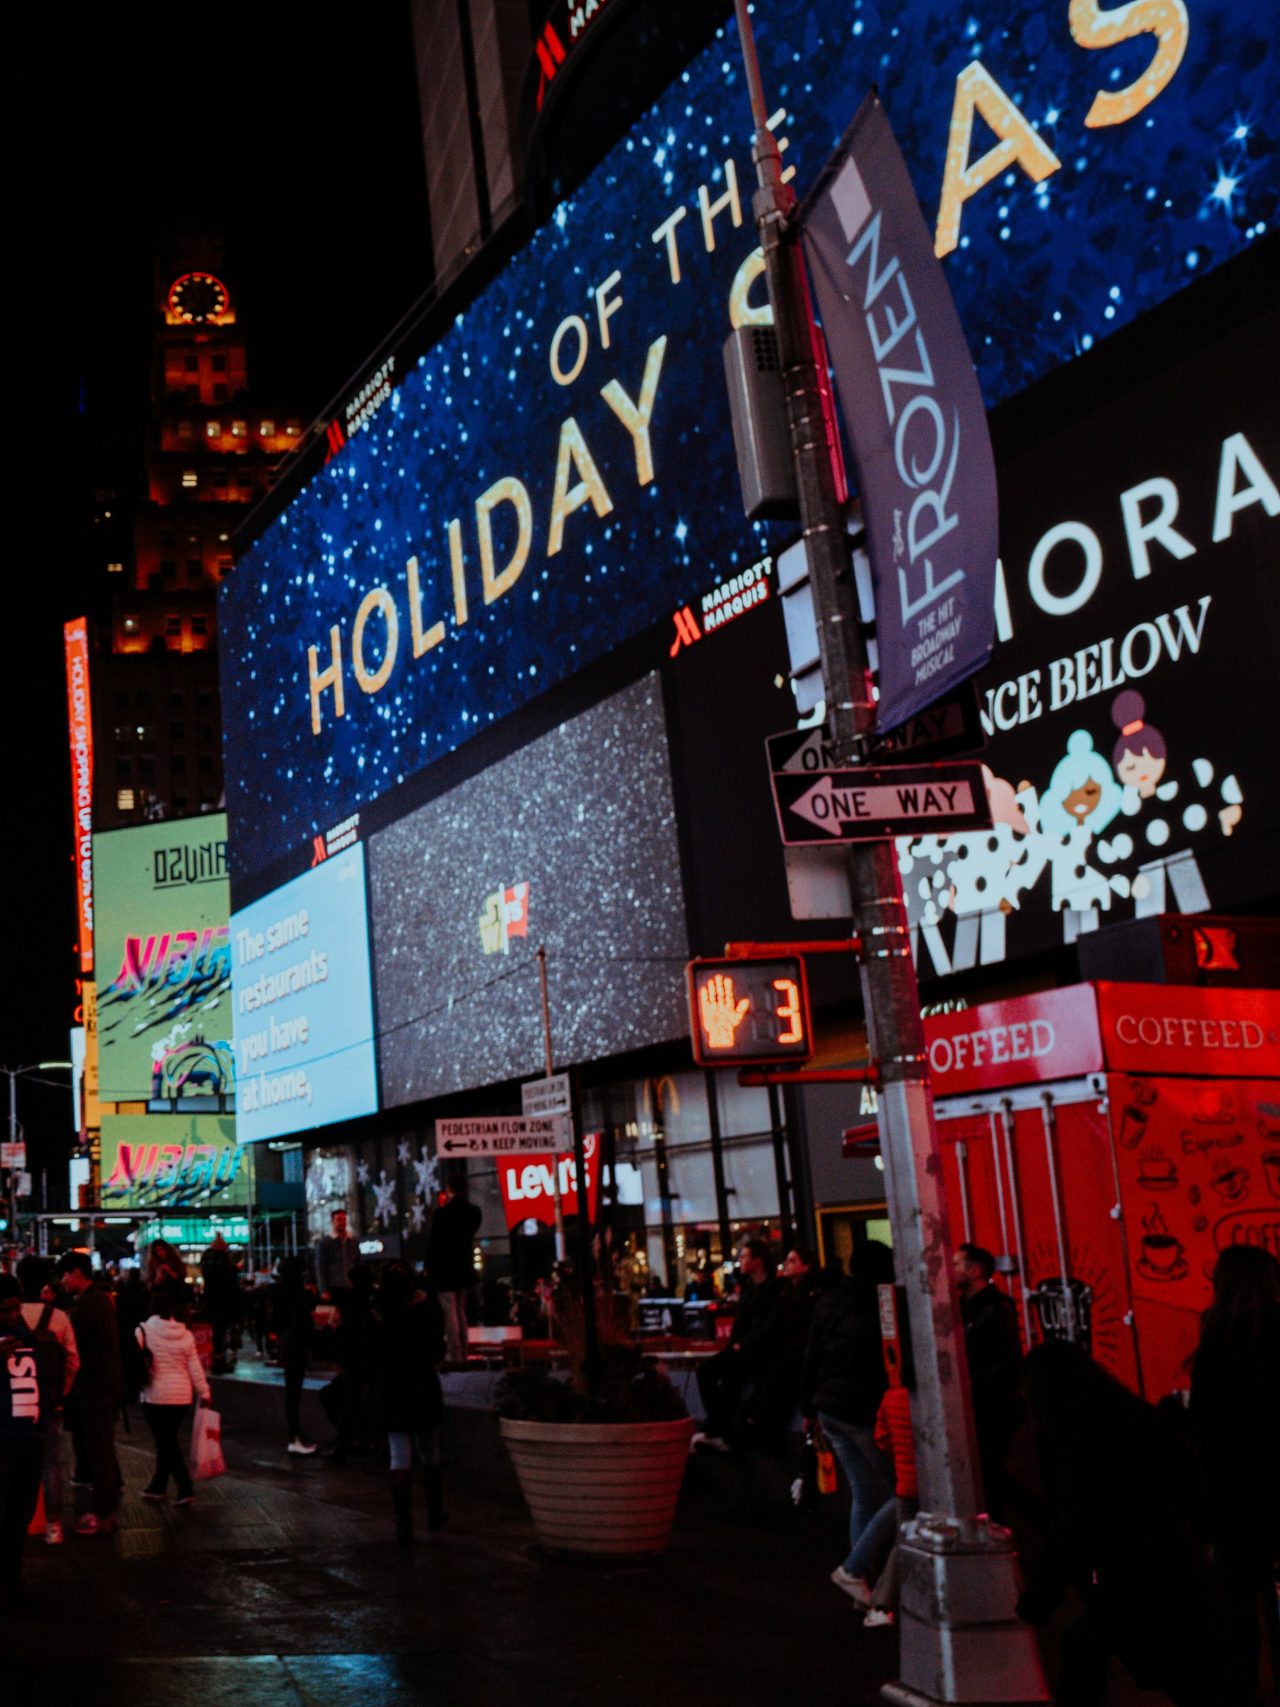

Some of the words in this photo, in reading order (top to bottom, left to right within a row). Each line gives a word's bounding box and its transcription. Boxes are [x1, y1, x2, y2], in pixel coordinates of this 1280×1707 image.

[549, 270, 623, 386] OF
[652, 107, 796, 285] THE
[845, 208, 967, 628] FROZEN
[307, 335, 668, 736] HOLIDAY
[993, 431, 1280, 643] ORA
[701, 556, 773, 613] MARRIOTT
[703, 581, 768, 632] MARQUIS
[911, 614, 963, 668] BROADWAY
[917, 610, 937, 639] THE
[937, 596, 955, 626] HIT
[915, 643, 955, 686] MUSICAL
[1049, 595, 1213, 712] BELOW
[71, 655, 87, 722] HOLIDAY
[73, 725, 91, 805] SHOPPING
[810, 791, 871, 819] ONE
[896, 786, 957, 814] WAY
[154, 841, 231, 883] OZUNA
[105, 925, 231, 995] NIBIR
[235, 925, 265, 966] The
[267, 907, 310, 948] same
[239, 950, 329, 1014] restaurants
[773, 979, 803, 1044] 3
[1116, 1014, 1265, 1050] COFFEED
[241, 1034, 268, 1075] you
[270, 1013, 309, 1050] have
[926, 1018, 1056, 1073] OFFEED
[242, 1082, 259, 1113] at
[260, 1068, 313, 1106] home,
[441, 1121, 499, 1136] PEDESTRIAN
[501, 1121, 527, 1135] FLOW
[529, 1119, 554, 1133] ZONE
[492, 1136, 516, 1150] KEEP
[518, 1135, 557, 1149] MOVING
